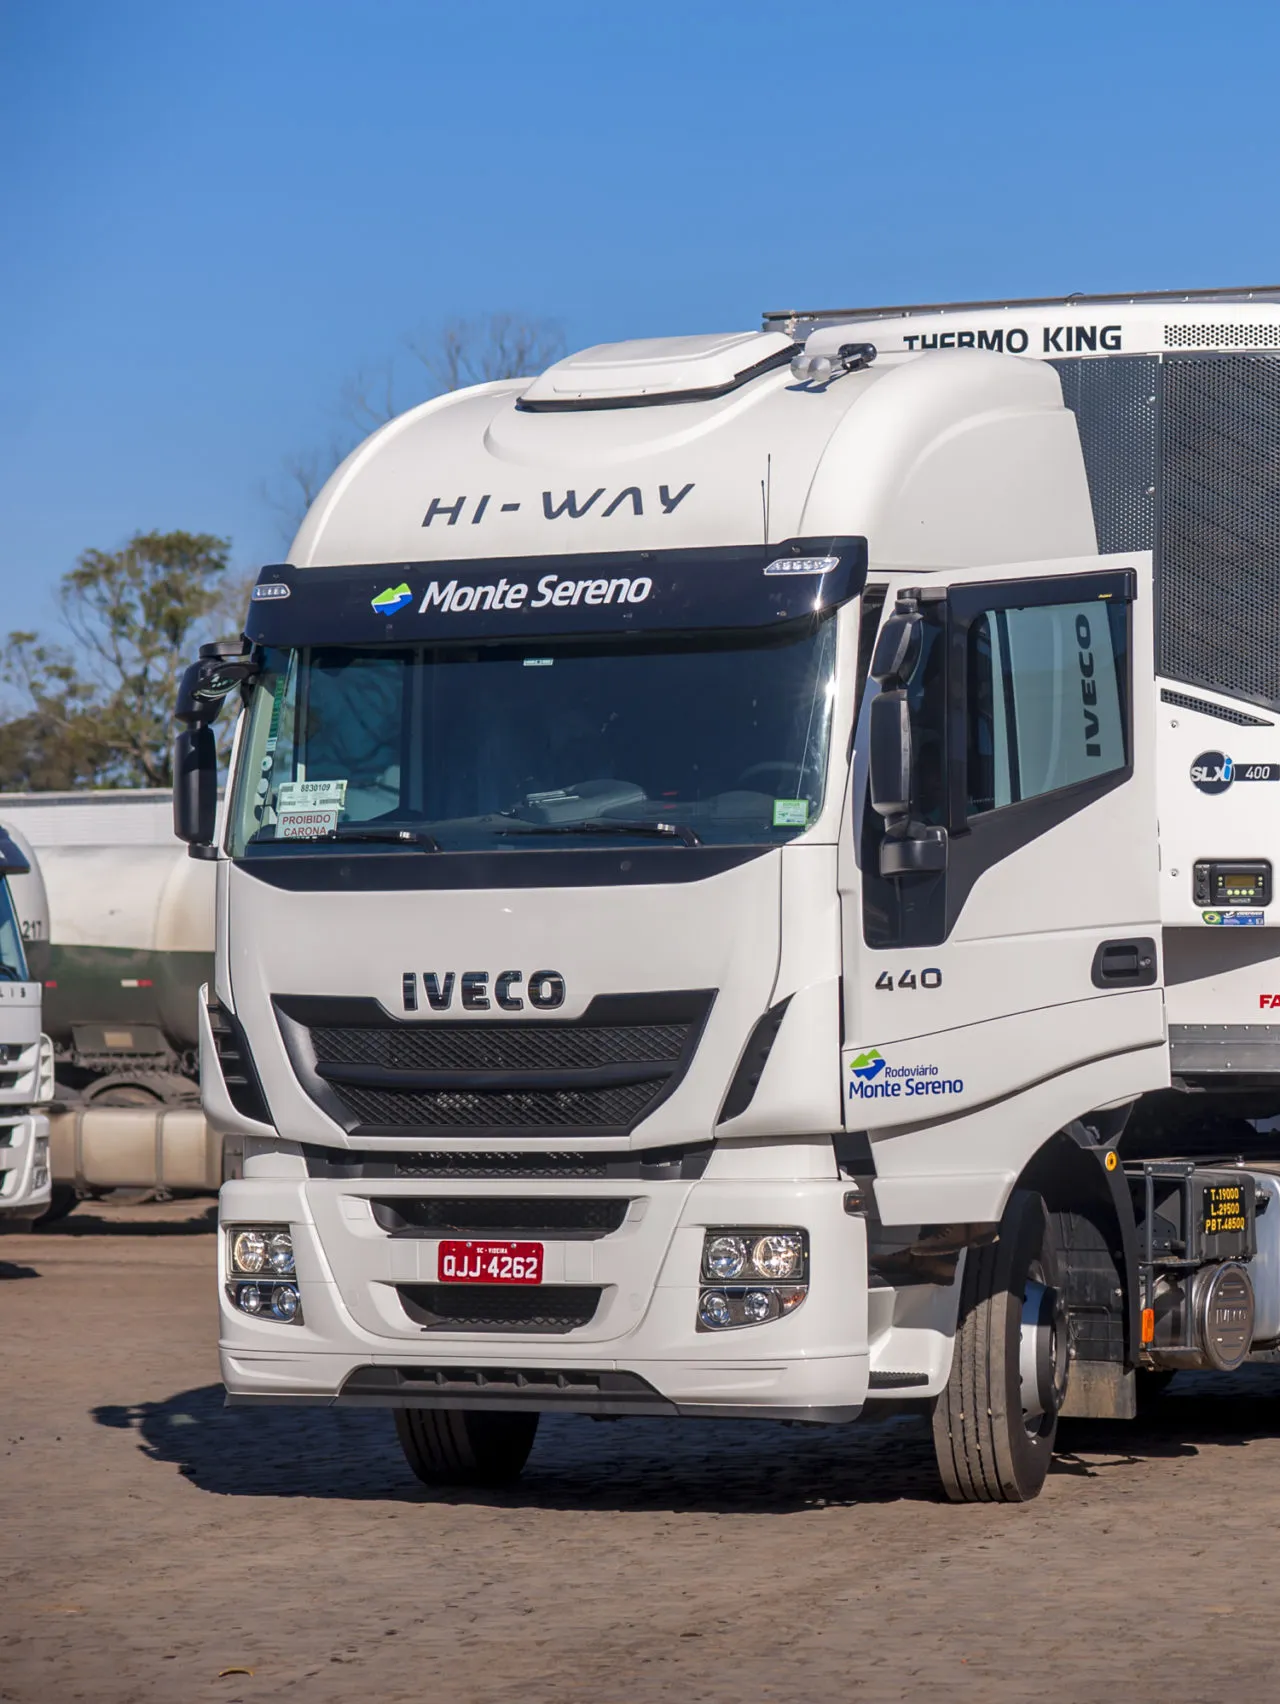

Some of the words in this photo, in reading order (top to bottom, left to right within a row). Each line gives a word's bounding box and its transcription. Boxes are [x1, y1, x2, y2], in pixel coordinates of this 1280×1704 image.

[903, 328, 1029, 354] THERMO
[1043, 325, 1122, 353] KING
[421, 483, 695, 528] HI-WAY
[419, 577, 526, 615] Monte
[530, 573, 653, 609] Sereno
[1074, 613, 1102, 757] IVECO
[1245, 766, 1271, 780] 400
[282, 814, 331, 825] PROIBIDO
[284, 826, 327, 837] CARONA
[402, 970, 567, 1012] IVECO
[875, 967, 943, 992] 440
[885, 1064, 939, 1078] Rodoviário
[849, 1080, 901, 1099] Monte
[905, 1077, 964, 1097] Sereno
